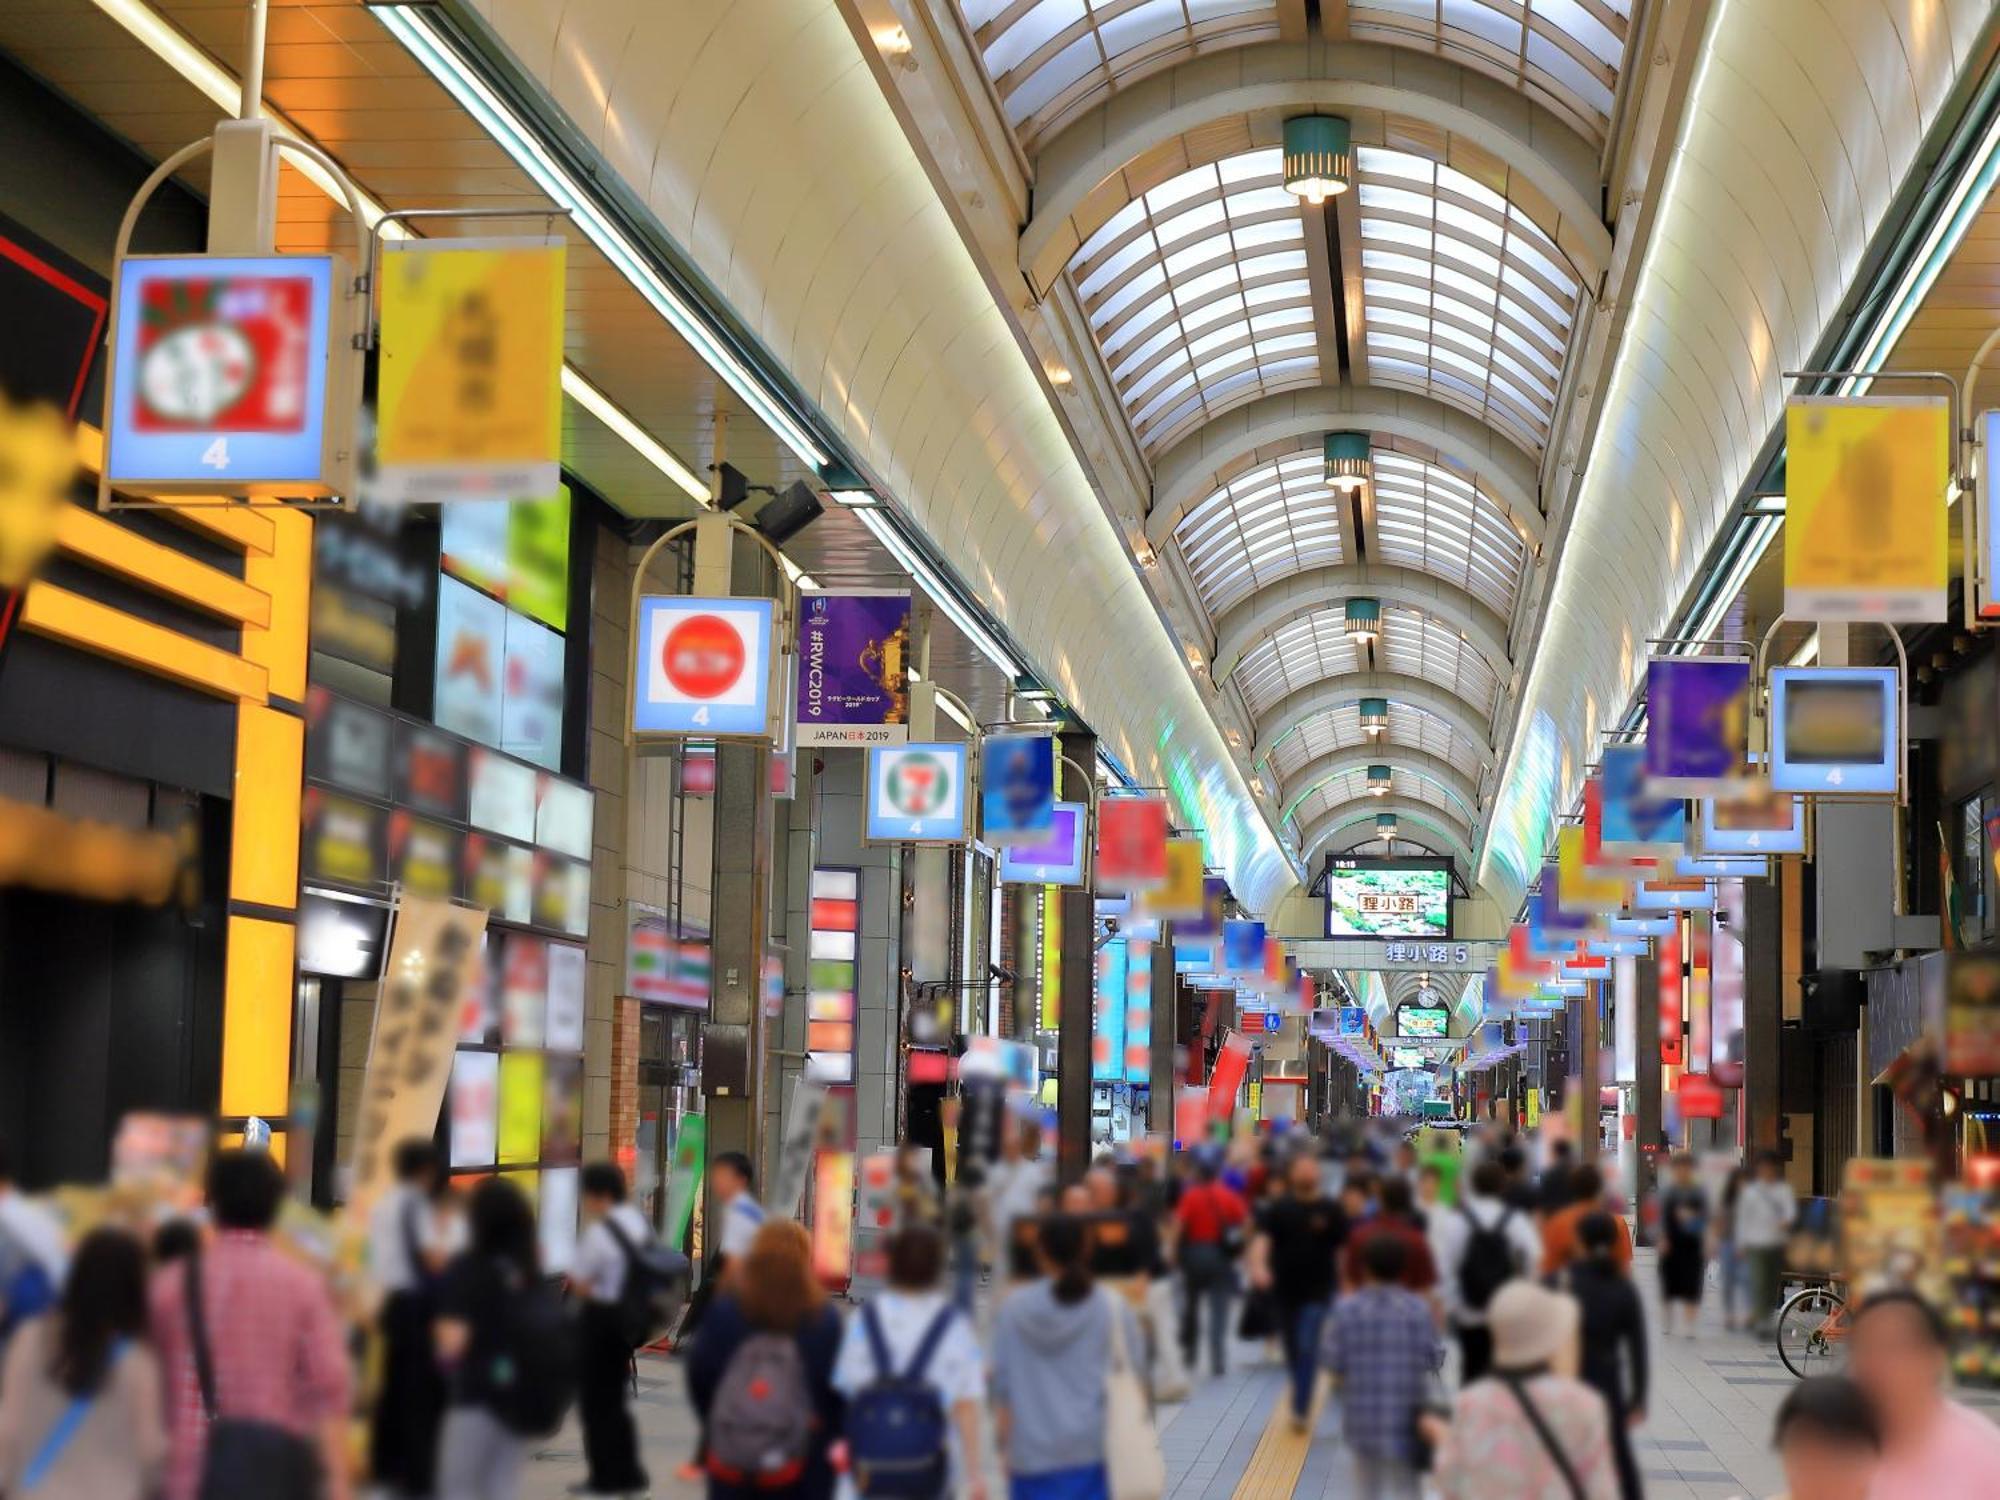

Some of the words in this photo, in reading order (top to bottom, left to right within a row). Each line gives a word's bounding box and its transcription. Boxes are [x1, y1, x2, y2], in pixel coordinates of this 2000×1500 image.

[202, 437, 231, 469] 4
[808, 630, 824, 716] #RWC2019
[691, 705, 711, 726] 4
[1826, 766, 1844, 785] 4
[909, 820, 923, 834] 4
[1746, 831, 1761, 847] 4
[1362, 896, 1415, 910] 狸小路
[1386, 943, 1447, 963] 狸小路
[1455, 946, 1467, 963] 5
